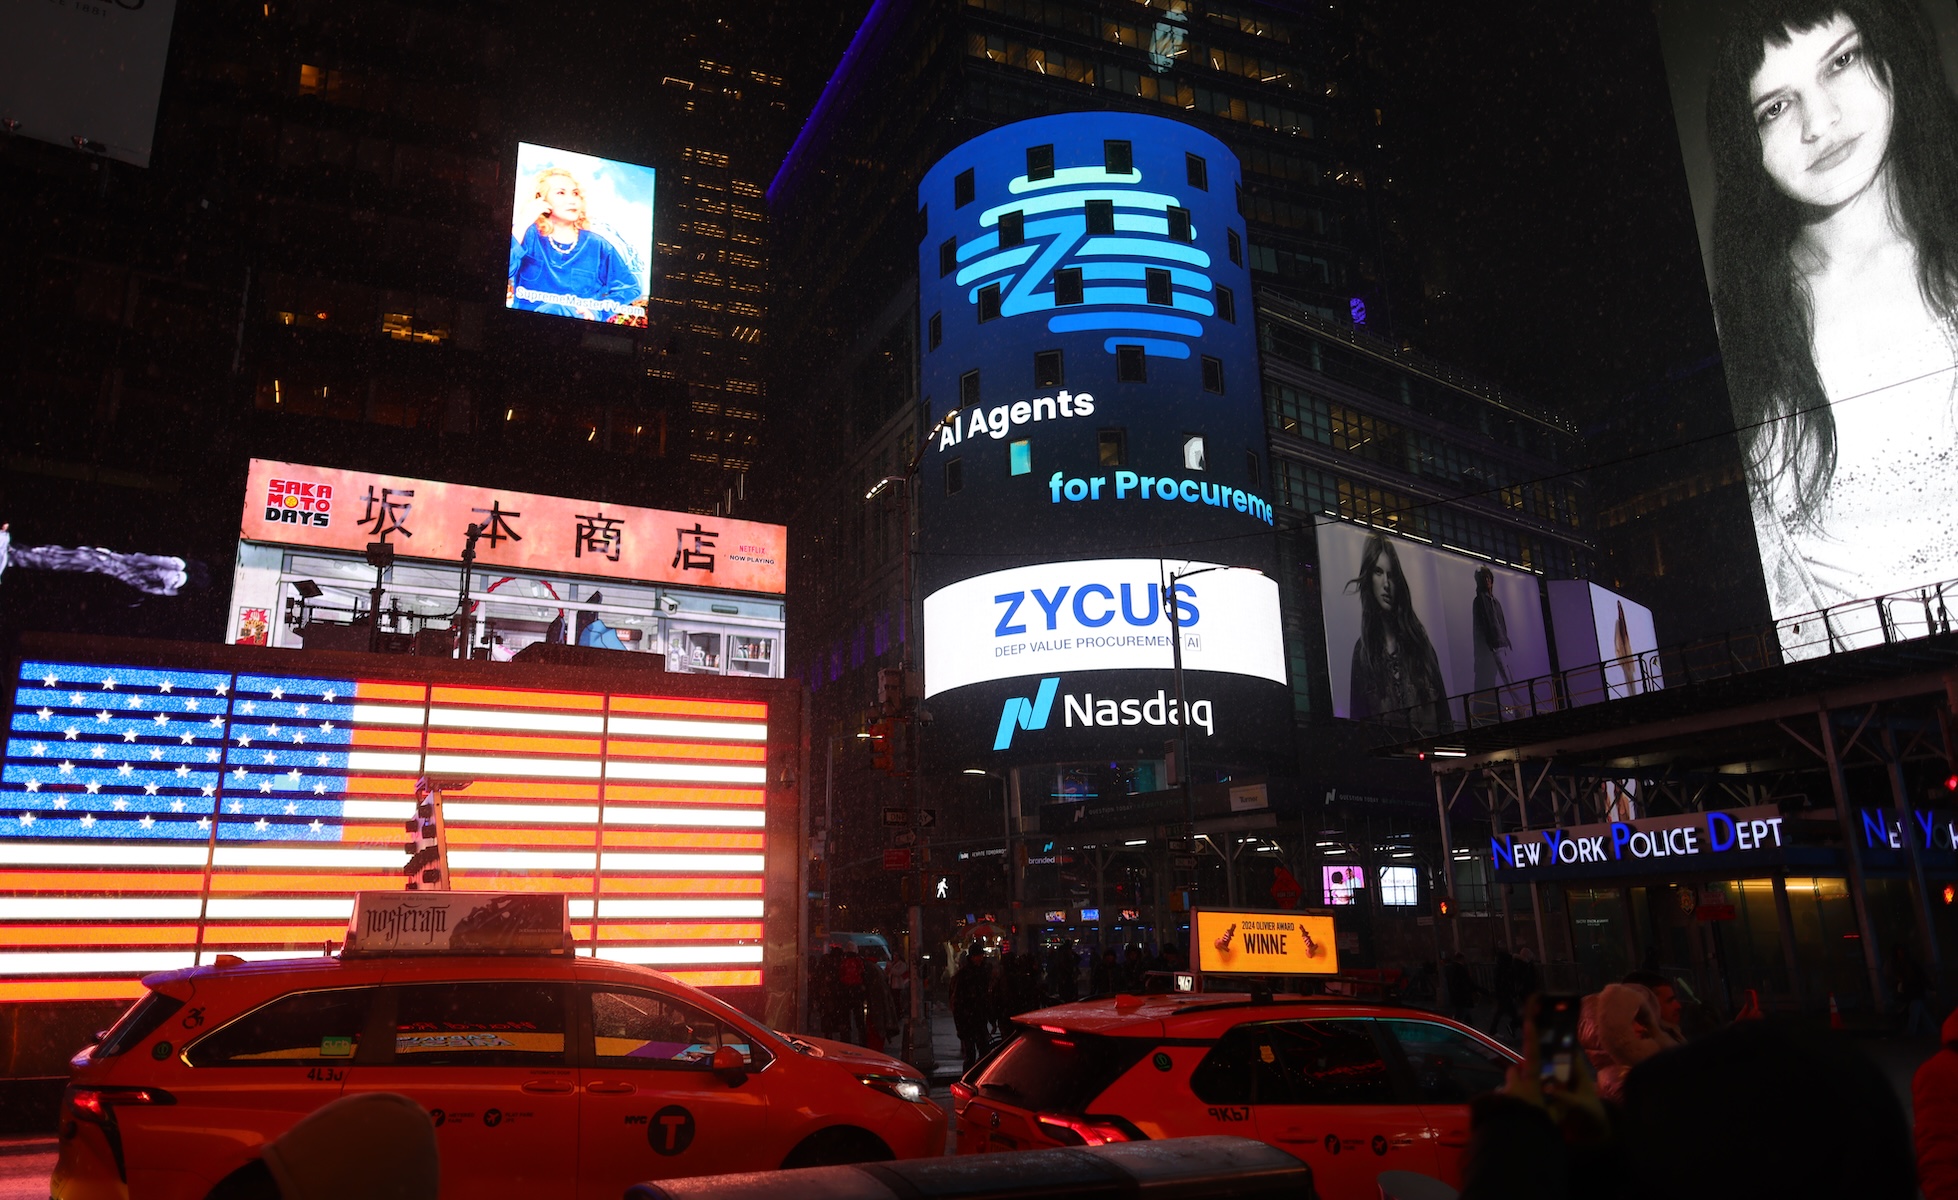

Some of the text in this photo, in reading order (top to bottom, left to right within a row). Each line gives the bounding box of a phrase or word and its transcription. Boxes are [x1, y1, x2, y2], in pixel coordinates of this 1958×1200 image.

[74, 2, 107, 17] 1881
[516, 286, 646, 317] SupremeMasterTV.com
[938, 389, 1095, 452] AI Agents
[269, 479, 332, 499] SAKA
[1048, 469, 1275, 527] for Procureme
[265, 507, 330, 527] DAYS
[356, 485, 719, 573] 坂本商店
[739, 545, 766, 555] NETFLIX
[746, 556, 775, 565] PLAYING
[994, 583, 1200, 638] ZYCUS
[995, 642, 1027, 658] DEEP
[1030, 638, 1072, 651] VALUE
[1187, 637, 1199, 648] AI
[1063, 689, 1214, 737] Nasdaq
[890, 813, 906, 821] ONE
[1088, 807, 1115, 816] QUESTION
[1116, 804, 1133, 812] TODAY
[1490, 811, 1783, 870] NEW YORK POLICE DEPT
[1028, 855, 1055, 865] branded
[1242, 921, 1295, 931] 2024 OLIVIER AWARD
[1243, 933, 1288, 955] WINNE
[1177, 976, 1193, 991] 9K67
[323, 1039, 349, 1049] curb
[624, 1114, 687, 1151] NYC T
